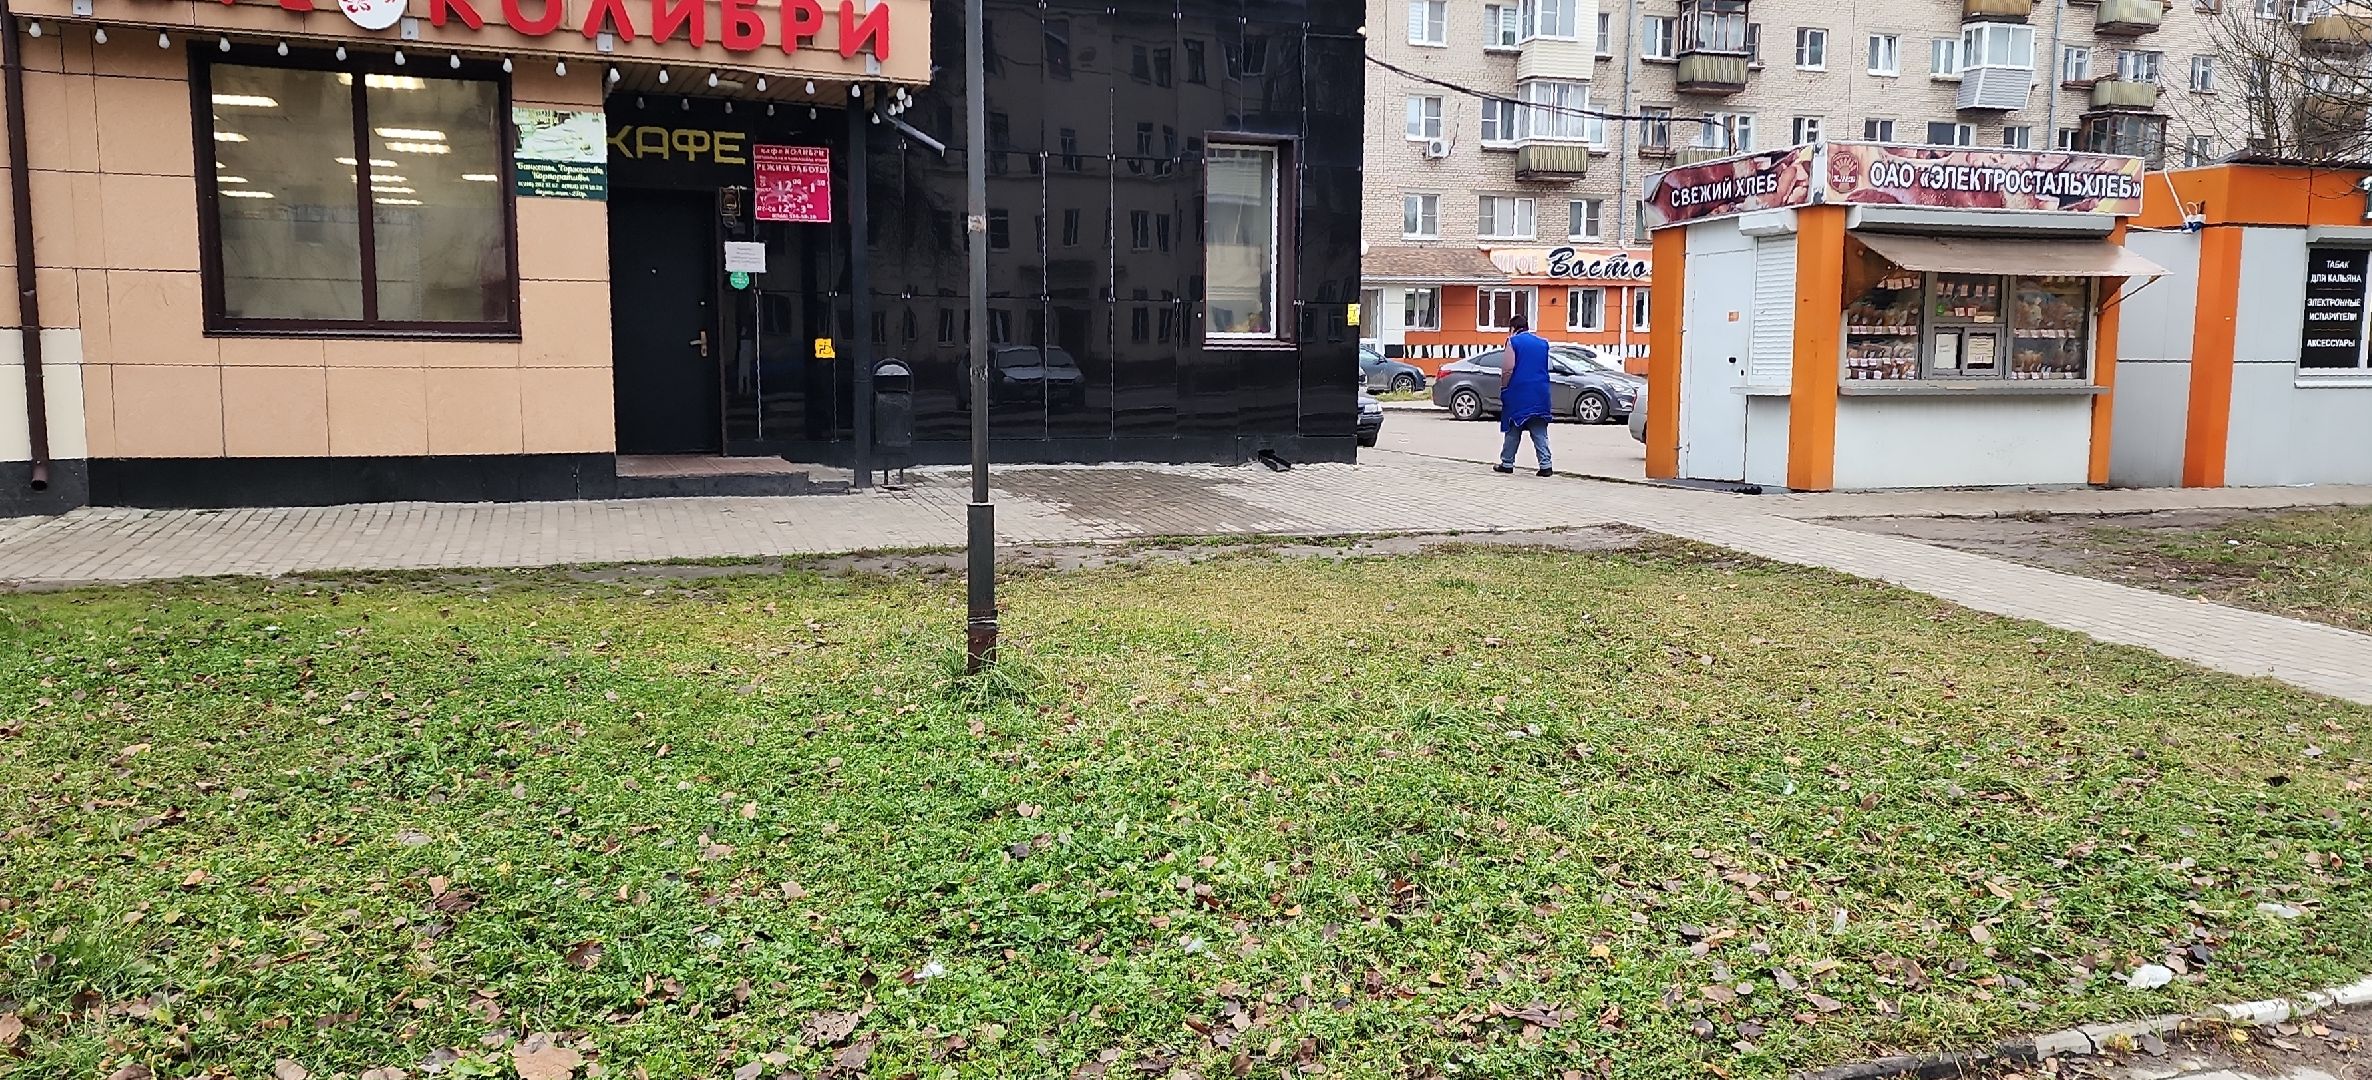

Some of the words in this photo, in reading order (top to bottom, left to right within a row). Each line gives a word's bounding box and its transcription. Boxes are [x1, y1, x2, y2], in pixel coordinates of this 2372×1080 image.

[608, 125, 746, 165] КАФЕ
[791, 165, 828, 173] РАБОТЫ
[1869, 161, 1915, 188] ОАО
[1920, 163, 2141, 198] «ЭЛЕКТРОСТАЛЬХЛЕБ»
[1671, 177, 1733, 208] СВЕЖИЙ
[1734, 173, 1778, 198] ХЛЕБ
[1548, 246, 1652, 278] Восто
[2326, 260, 2350, 268] ТАБАК
[2310, 273, 2326, 283] ДЛЯ
[2327, 274, 2362, 283] КАЛЬЯНА
[2307, 298, 2361, 307] ЭЛЕКТРОННЫЕ
[2309, 312, 2357, 321] ИСПАРИТЕЛИ
[2306, 339, 2356, 348] АКСЕССУАРЫ
